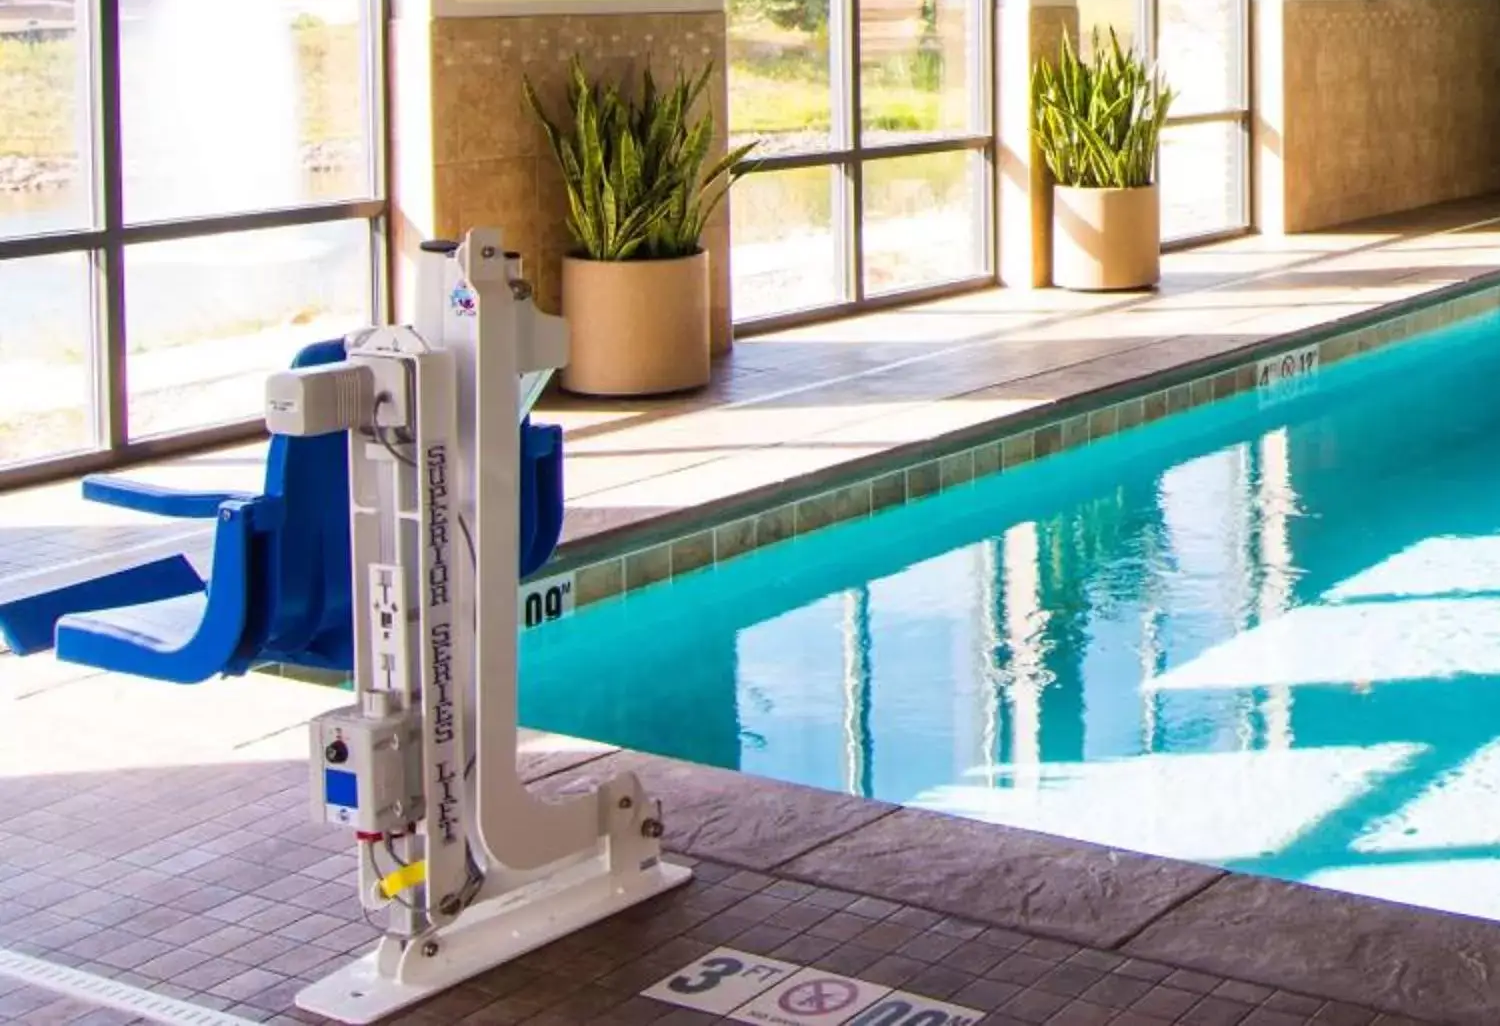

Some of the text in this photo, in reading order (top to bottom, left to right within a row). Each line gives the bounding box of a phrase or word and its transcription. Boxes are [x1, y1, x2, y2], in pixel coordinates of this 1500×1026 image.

[428, 445, 458, 846] SUPERIOR SERIES LIFT
